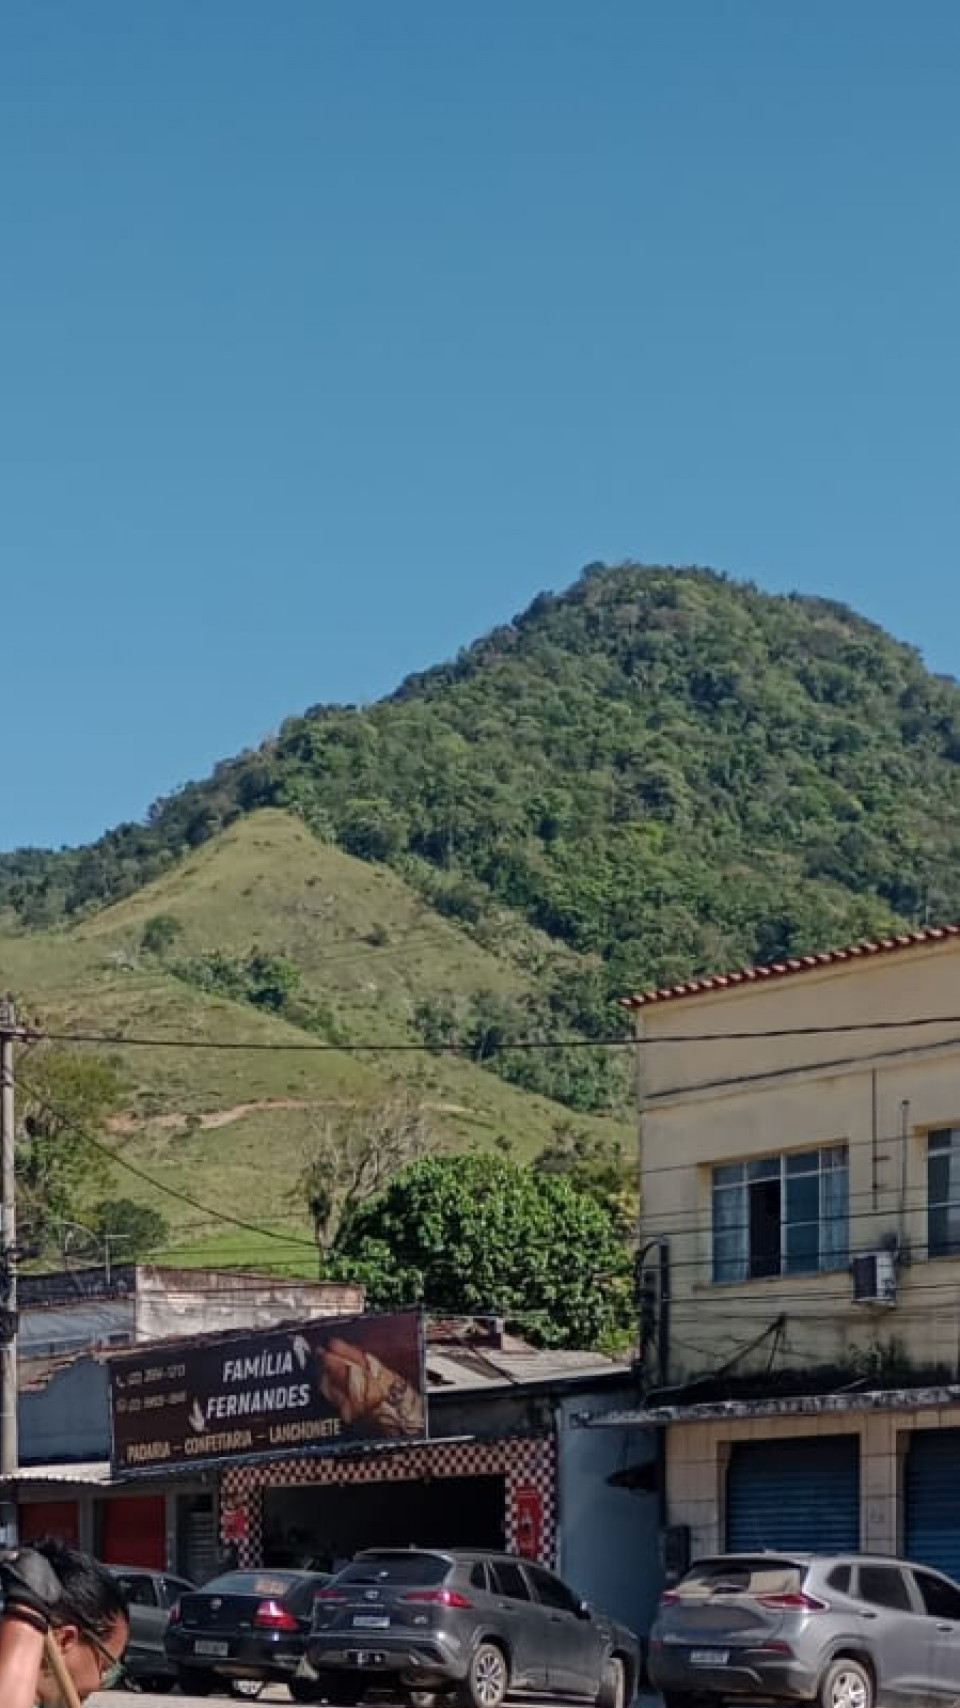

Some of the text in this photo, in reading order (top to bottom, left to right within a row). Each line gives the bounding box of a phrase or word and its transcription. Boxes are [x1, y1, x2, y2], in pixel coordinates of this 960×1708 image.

[222, 1349, 293, 1383] FAMÍLIA
[206, 1383, 311, 1419] FERNANDES
[269, 1418, 341, 1444] LANCHONETE
